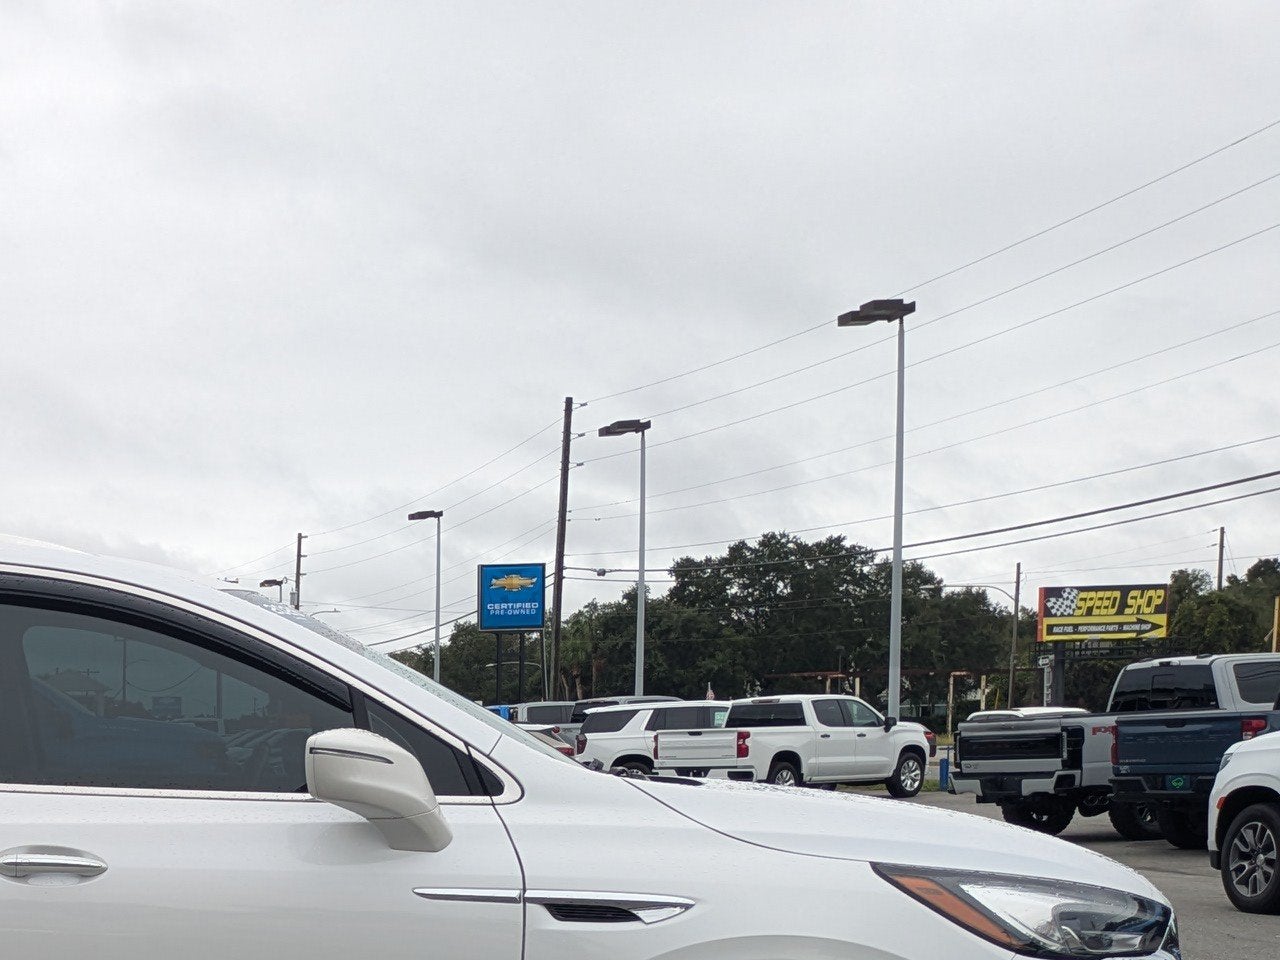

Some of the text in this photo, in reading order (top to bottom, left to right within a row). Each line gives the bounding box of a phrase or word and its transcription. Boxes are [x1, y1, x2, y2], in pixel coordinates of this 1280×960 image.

[487, 602, 539, 610] CERTIFIED
[1073, 590, 1165, 616] SPEED SHOP
